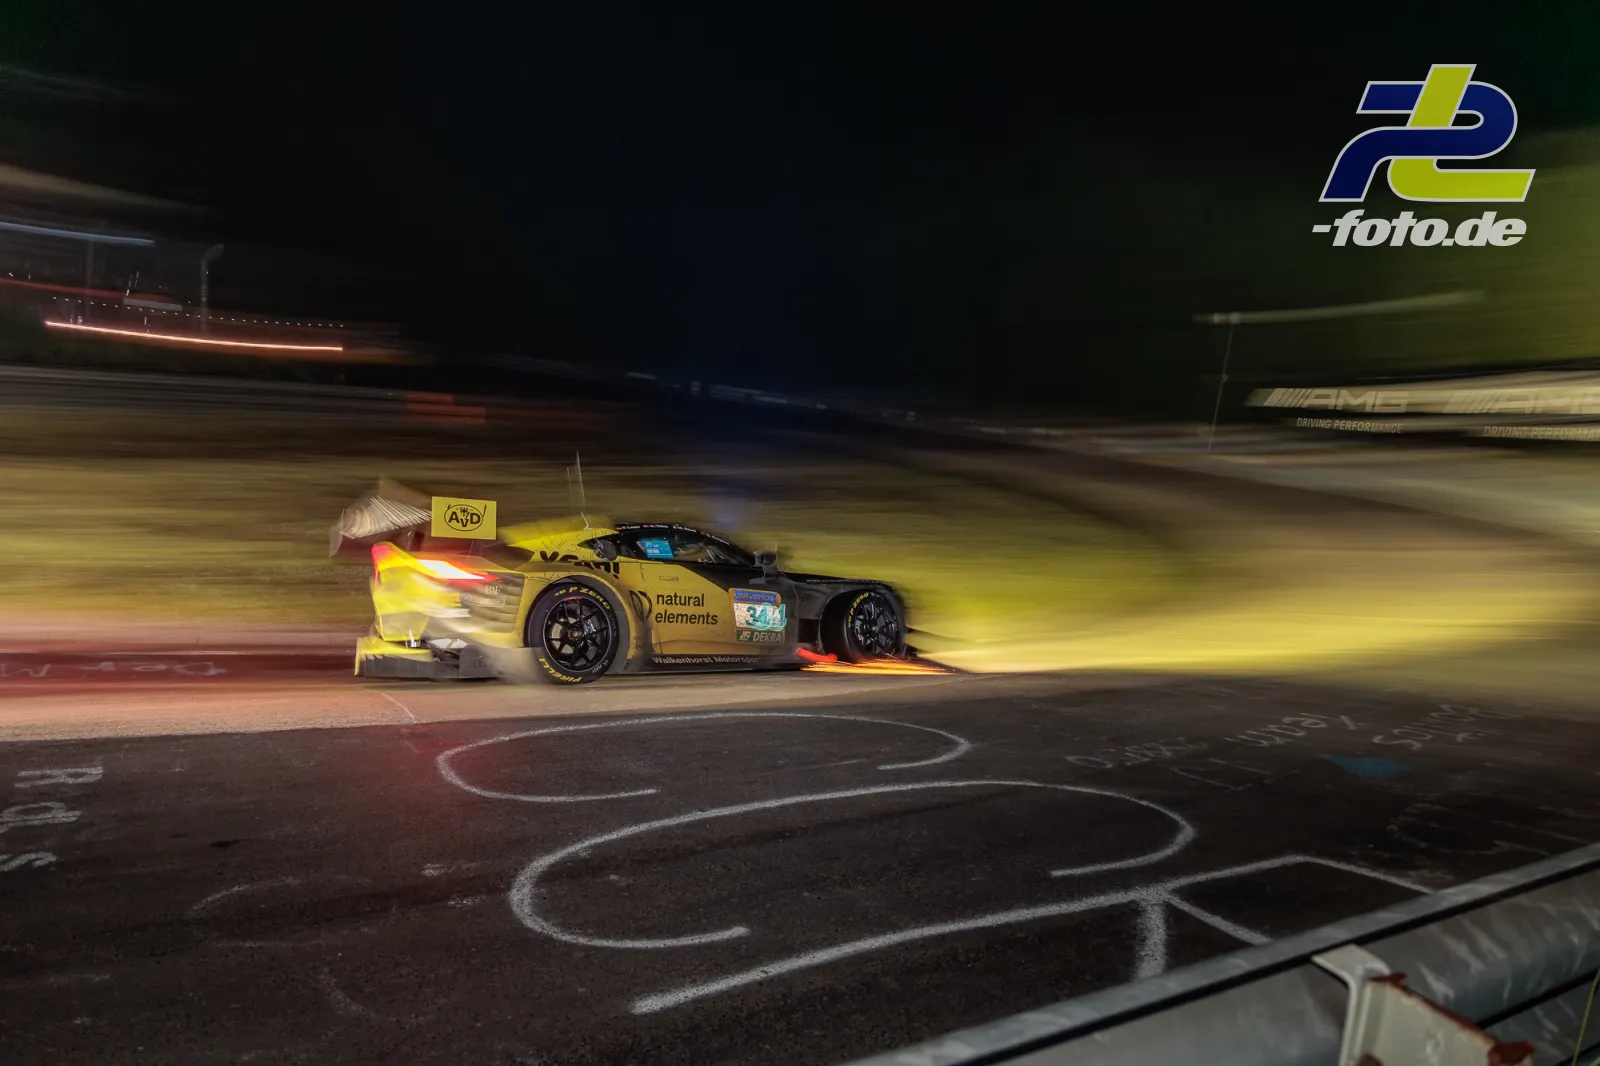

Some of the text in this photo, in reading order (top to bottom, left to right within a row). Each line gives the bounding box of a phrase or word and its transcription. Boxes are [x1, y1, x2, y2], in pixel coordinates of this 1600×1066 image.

[1306, 388, 1410, 413] AMG
[1296, 418, 1403, 434] DRIVING PERFORMANCE
[1483, 426, 1529, 438] DRIVING
[656, 592, 705, 607] natural
[655, 609, 718, 625] elements
[752, 631, 782, 642] DEKRA
[652, 655, 713, 664] Walkenhorst
[538, 657, 583, 684] PIRELLI
